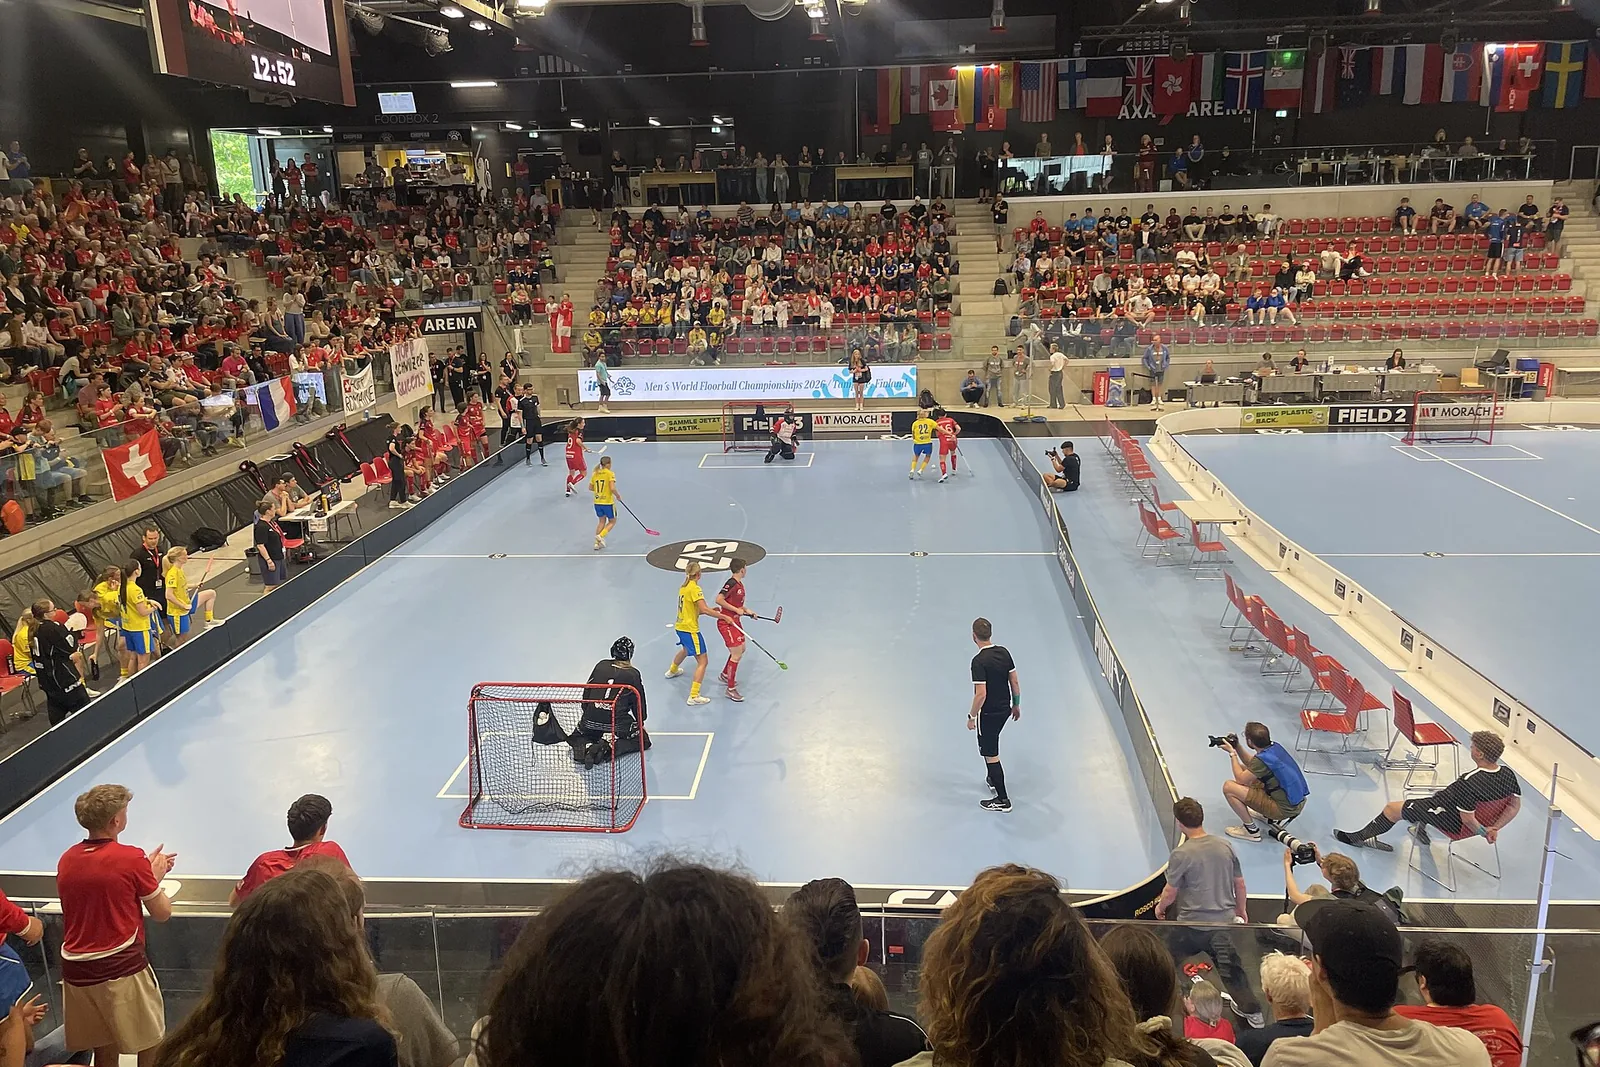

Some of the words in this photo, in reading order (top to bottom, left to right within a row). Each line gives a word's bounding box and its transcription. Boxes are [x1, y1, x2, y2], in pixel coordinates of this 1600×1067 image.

[251, 54, 297, 87] 12:52
[374, 113, 430, 124] FOODBOX
[432, 113, 439, 123] 2
[1117, 104, 1156, 120] AXA
[424, 316, 478, 332] ARENA
[672, 381, 699, 391] World
[699, 380, 737, 391] Floorball
[738, 379, 803, 392] Championships
[1337, 408, 1393, 423] FIELD
[1394, 408, 1407, 423] 2
[1440, 406, 1491, 417] MORACH
[668, 418, 699, 426] SAMMLE
[833, 414, 878, 425] MORACH
[918, 423, 929, 435] 22
[567, 436, 573, 449] 9
[595, 479, 605, 494] 17
[1133, 900, 1154, 917] ROSCO
